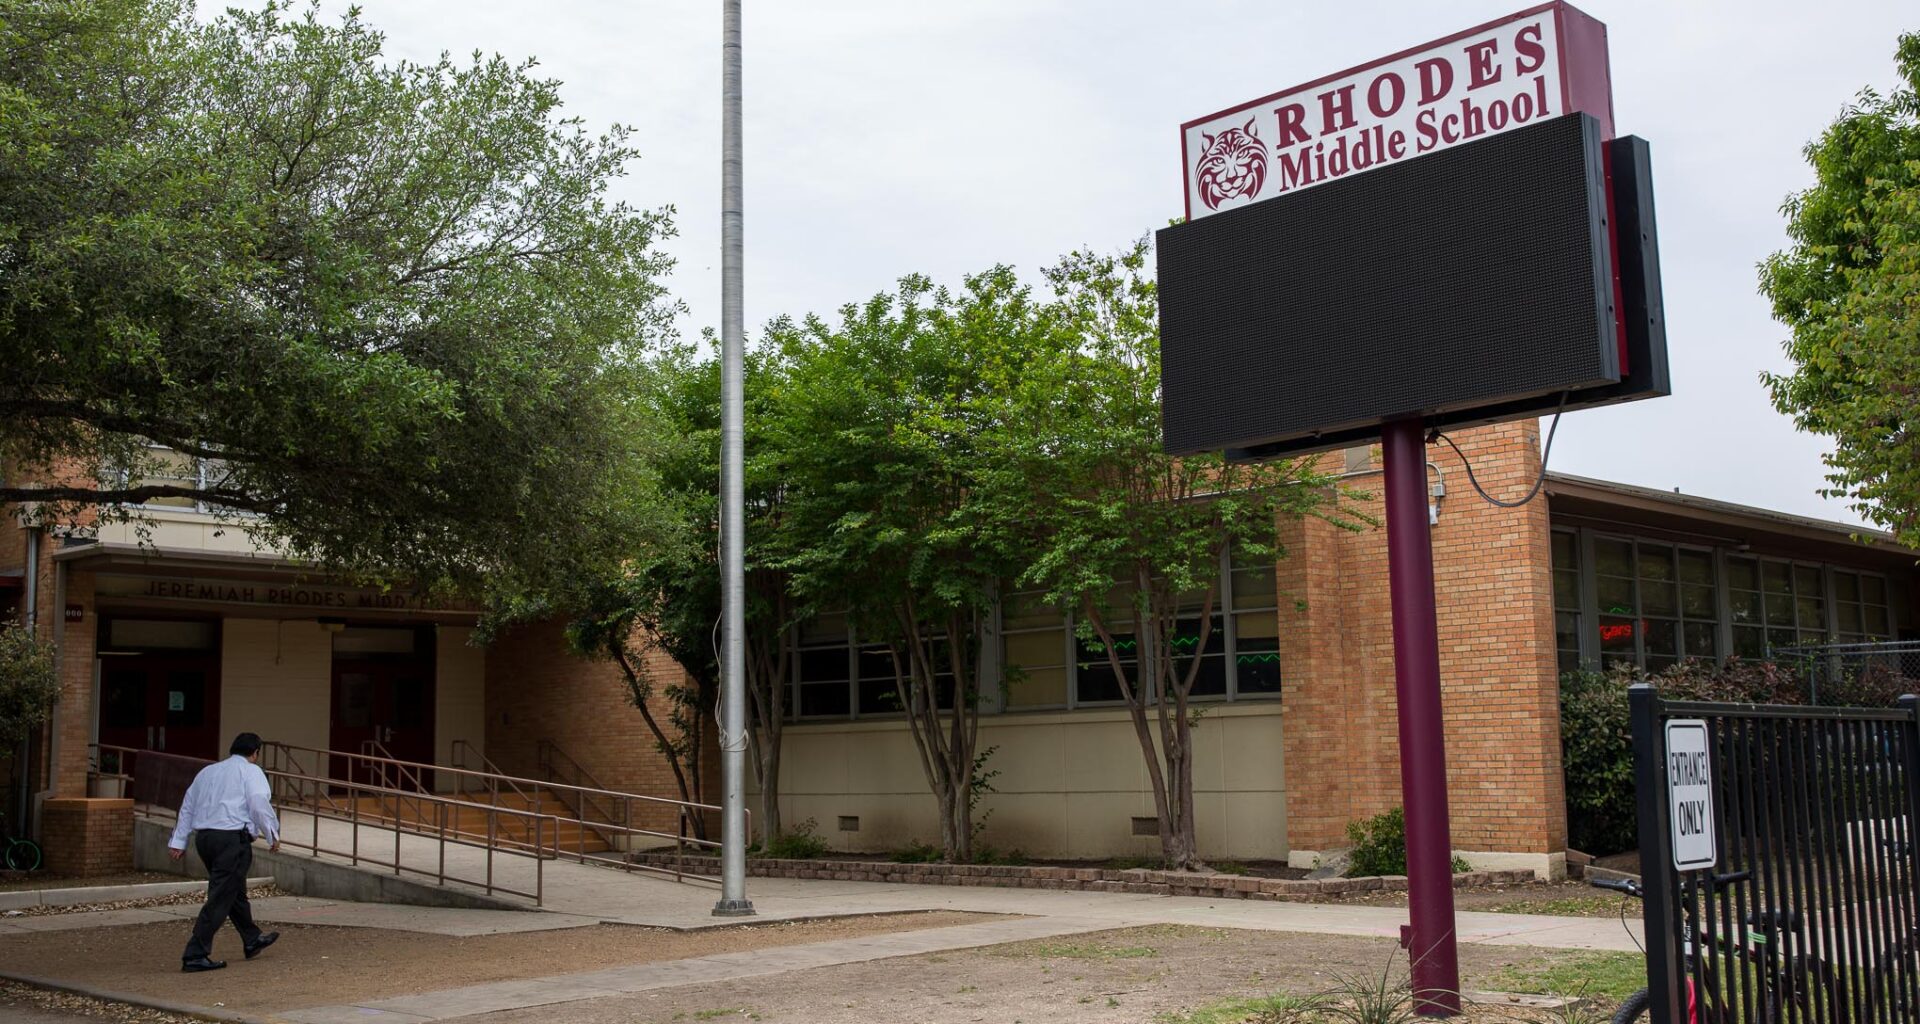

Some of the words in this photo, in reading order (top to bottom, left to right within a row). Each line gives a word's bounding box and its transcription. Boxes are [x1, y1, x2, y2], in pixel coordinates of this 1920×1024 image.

[1274, 22, 1546, 150] RHODES
[1277, 124, 1406, 193] Middle
[1415, 75, 1550, 153] School
[143, 581, 254, 603] JEREMIAH
[268, 588, 346, 607] RHODES
[1671, 751, 1707, 786] ENTRANCE
[1678, 800, 1705, 836] ONLY
